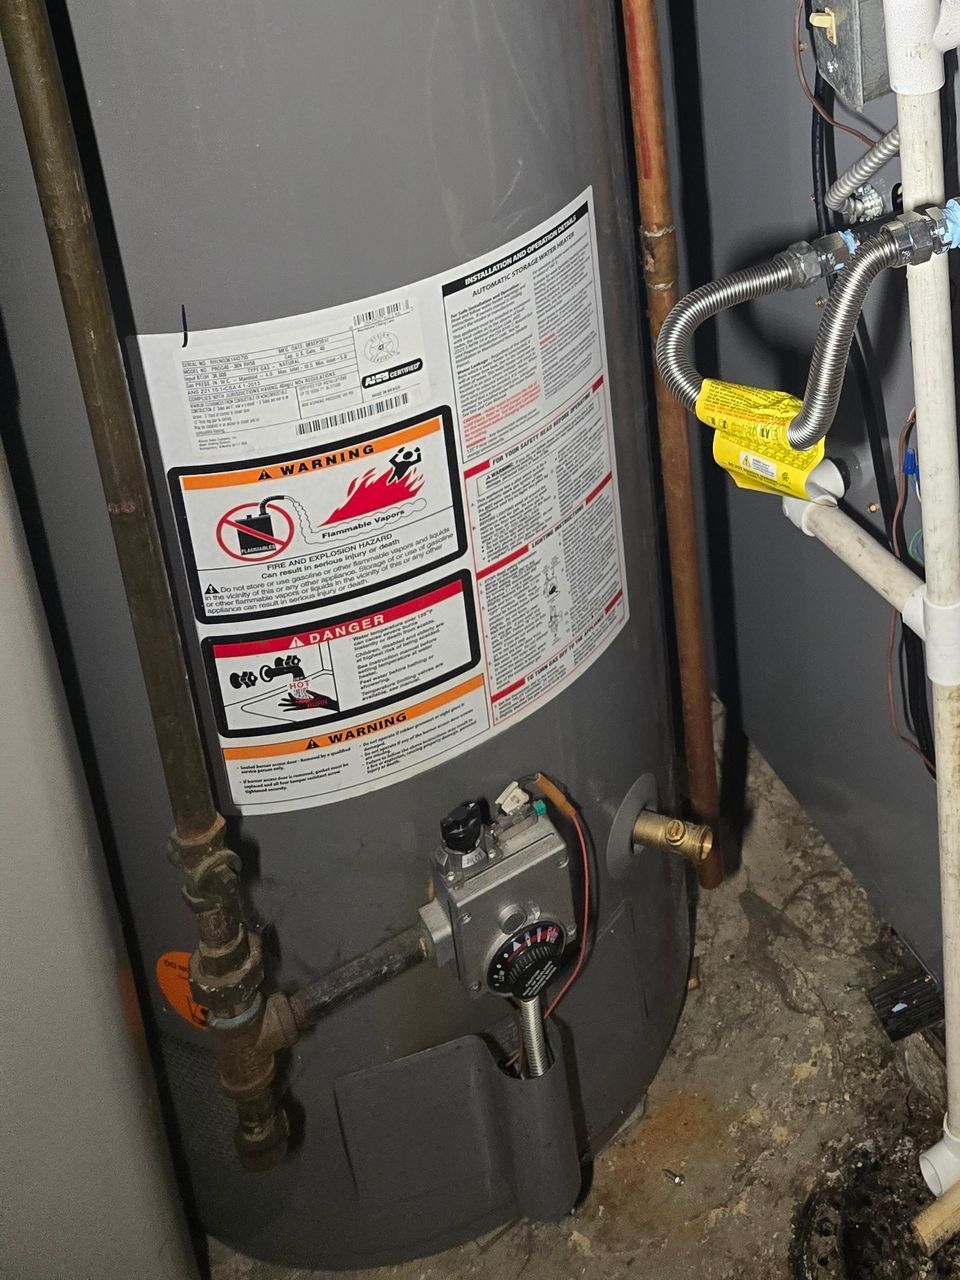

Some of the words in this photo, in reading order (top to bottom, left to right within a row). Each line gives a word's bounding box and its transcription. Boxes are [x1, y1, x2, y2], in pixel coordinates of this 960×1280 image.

[465, 258, 512, 287] INSTALLATION
[513, 250, 526, 263] AND
[527, 231, 558, 254] OPERATION
[558, 214, 577, 232] DETAILS
[472, 273, 511, 297] AUTOMATIC
[511, 258, 539, 278] STORAGE
[539, 246, 557, 261] WATER
[557, 231, 575, 248] HEATER
[390, 362, 421, 378] CERTIFIED
[492, 456, 503, 466] FOR
[505, 446, 519, 459] YOUR
[520, 433, 539, 450] SAFETY
[540, 424, 552, 437] READ
[553, 411, 570, 427] BEFORE
[570, 391, 590, 413] OPERATING
[280, 445, 375, 476] WARNING
[321, 521, 372, 539] Flammable
[374, 509, 405, 526] Vapors
[213, 592, 224, 600] the
[226, 589, 250, 598] vicinity
[261, 586, 274, 594] this
[285, 583, 299, 591] any
[300, 579, 319, 588] other
[321, 568, 356, 584] appliance.
[358, 558, 385, 573] Storage
[388, 554, 394, 563] of
[396, 553, 402, 561] or
[404, 547, 417, 558] use
[419, 543, 424, 552] of
[426, 532, 454, 551] gasoline
[247, 582, 266, 591] store
[276, 578, 290, 586] use
[292, 572, 322, 585] gasoline
[324, 568, 331, 576] or
[333, 563, 350, 573] other
[353, 551, 390, 568] flammable
[390, 542, 414, 556] vapors
[415, 535, 428, 546] and
[430, 527, 450, 541] liquids
[262, 571, 278, 580] Can
[280, 566, 302, 576] result
[304, 564, 310, 572] in
[313, 557, 342, 570] serious
[345, 550, 366, 562] injury
[380, 539, 400, 551] death
[267, 562, 285, 571] FIRE
[289, 557, 306, 568] AND
[310, 544, 356, 563] EXPLOSION
[359, 534, 392, 550] HAZARD
[215, 598, 234, 606] other
[236, 593, 272, 604] flammable
[274, 589, 300, 599] vapors
[310, 581, 333, 593] liquids
[335, 578, 342, 586] in
[344, 575, 354, 583] the
[357, 566, 380, 579] vicinity
[382, 563, 388, 571] of
[390, 559, 402, 569] this
[404, 557, 410, 565] or
[412, 551, 424, 562] any
[426, 544, 442, 556] other
[208, 605, 242, 615] appliance
[259, 599, 279, 609] result
[289, 592, 315, 603] serious
[317, 586, 336, 597] injury
[338, 584, 346, 592] or
[348, 577, 368, 589] death.
[309, 614, 385, 644] DANGER
[289, 679, 310, 690] HOT
[535, 665, 548, 676] TURN
[328, 712, 407, 744] WARNING
